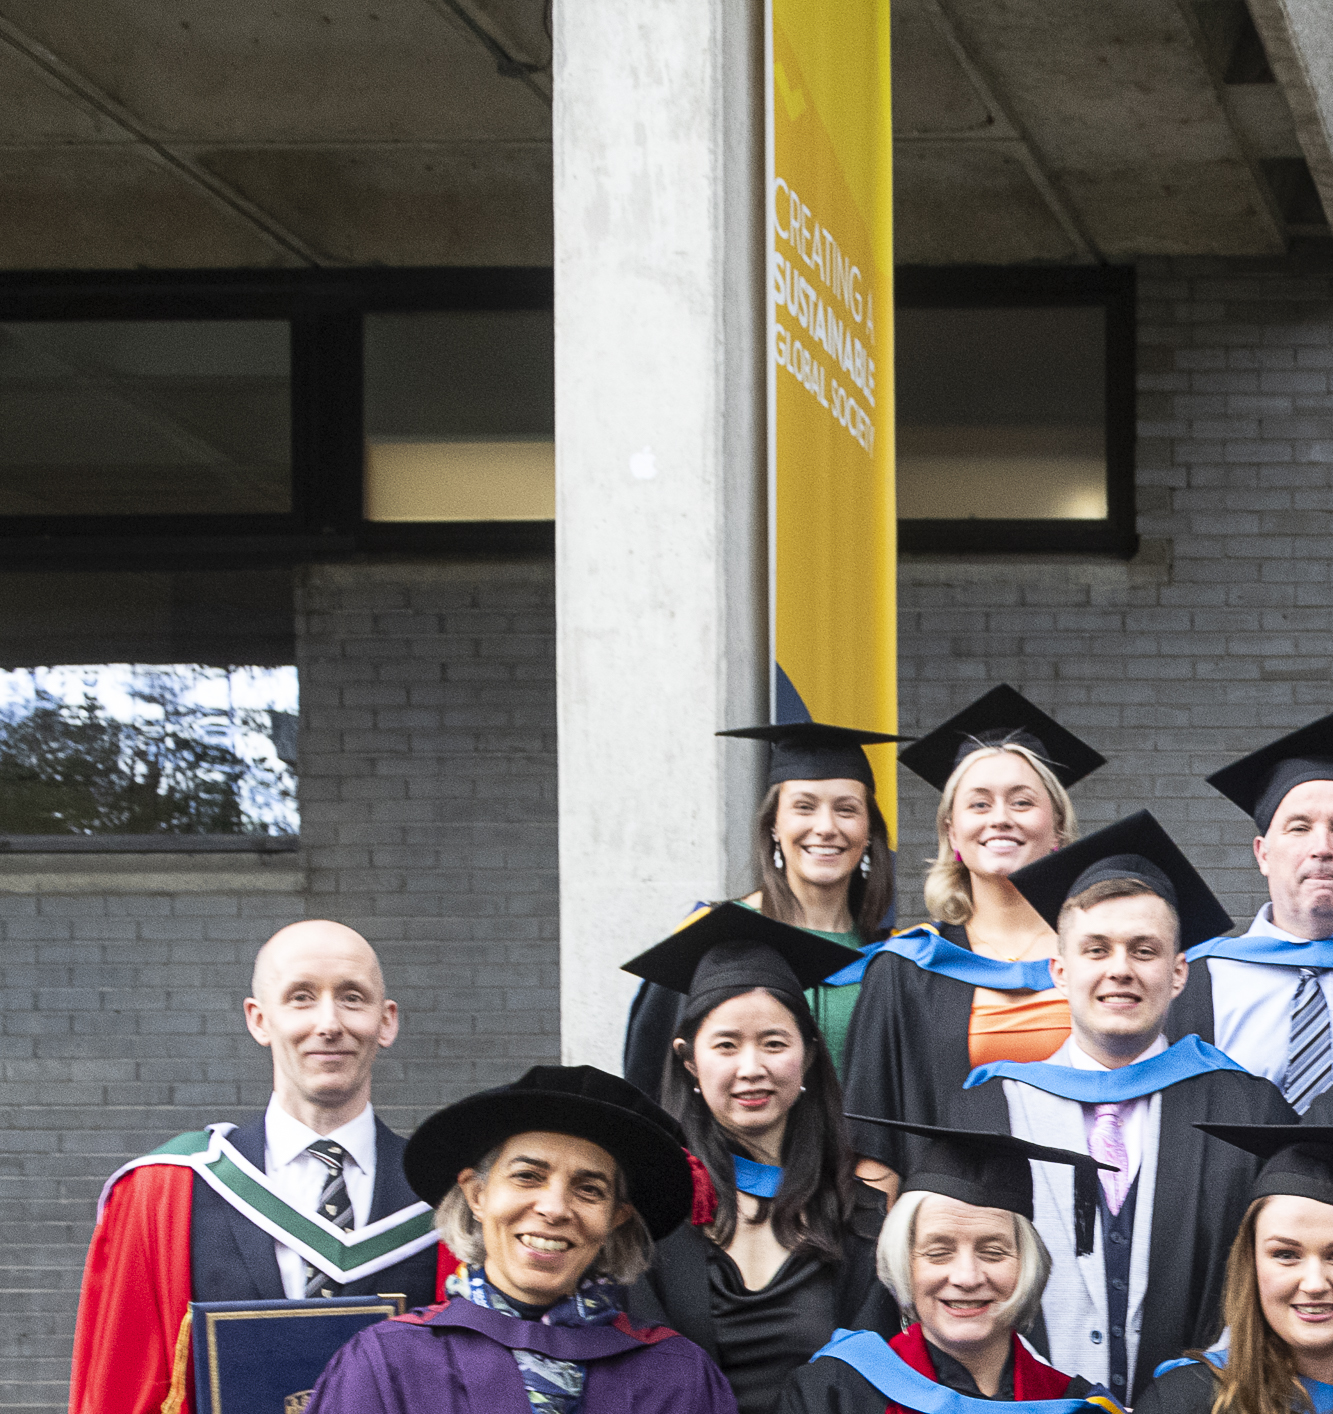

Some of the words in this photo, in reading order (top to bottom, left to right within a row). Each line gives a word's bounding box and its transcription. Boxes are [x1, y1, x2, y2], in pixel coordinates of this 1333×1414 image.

[774, 176, 863, 324] CREATING
[865, 291, 876, 346] A
[774, 251, 876, 407] SUSTAINABLE
[774, 322, 829, 409] GLOBAL
[831, 378, 875, 459] SOCIETY
